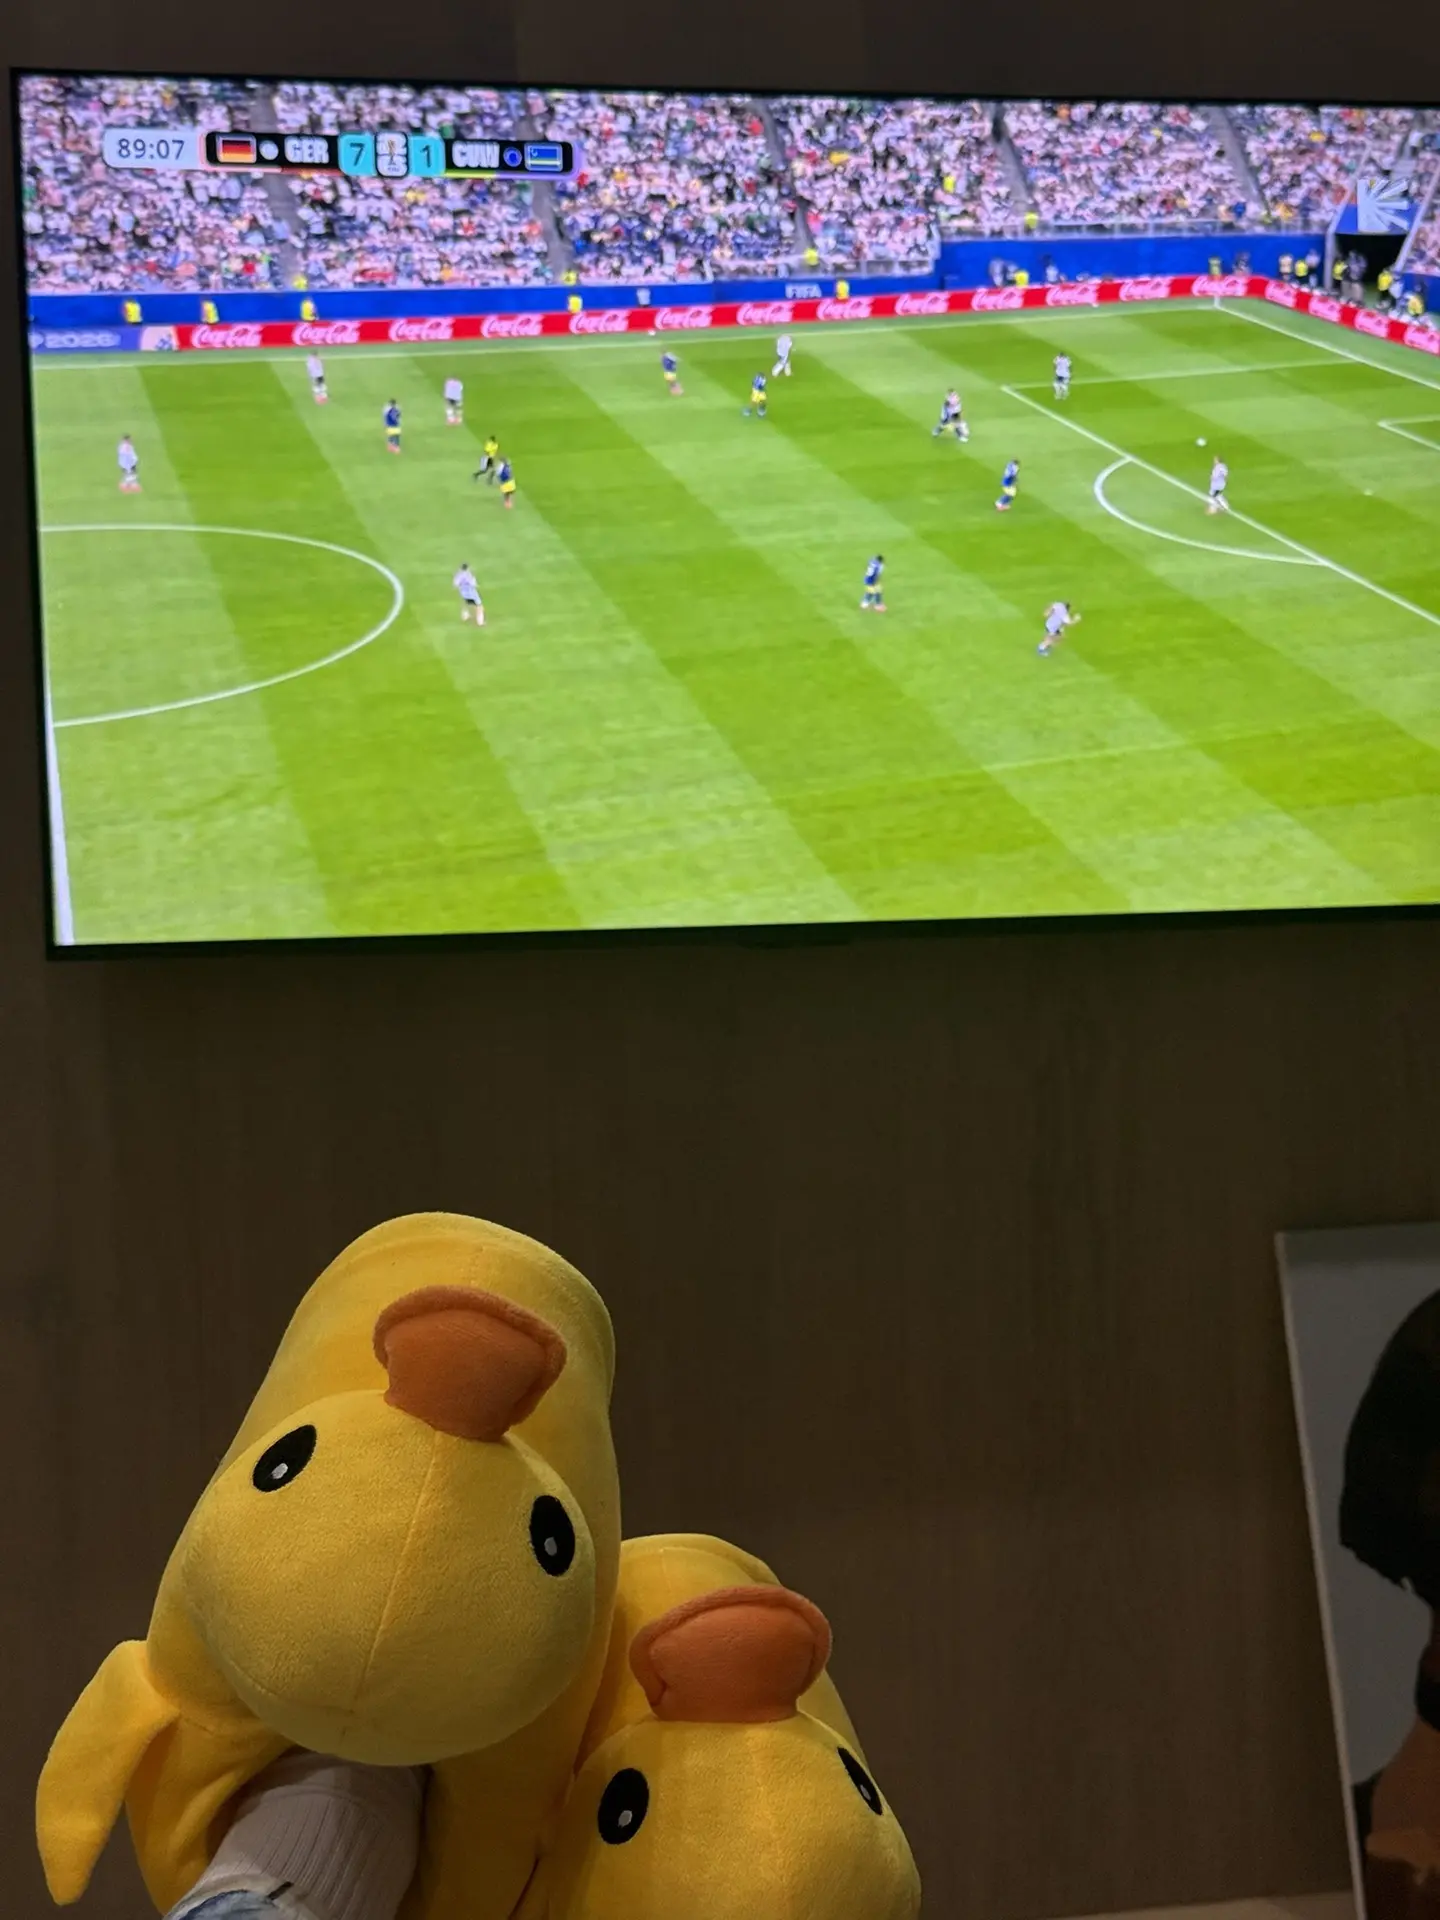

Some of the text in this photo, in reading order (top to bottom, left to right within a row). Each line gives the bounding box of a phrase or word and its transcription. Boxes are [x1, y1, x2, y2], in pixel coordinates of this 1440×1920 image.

[117, 138, 184, 160] 89:07
[284, 136, 330, 163] GER
[350, 142, 364, 166] 7
[420, 145, 431, 167] 1
